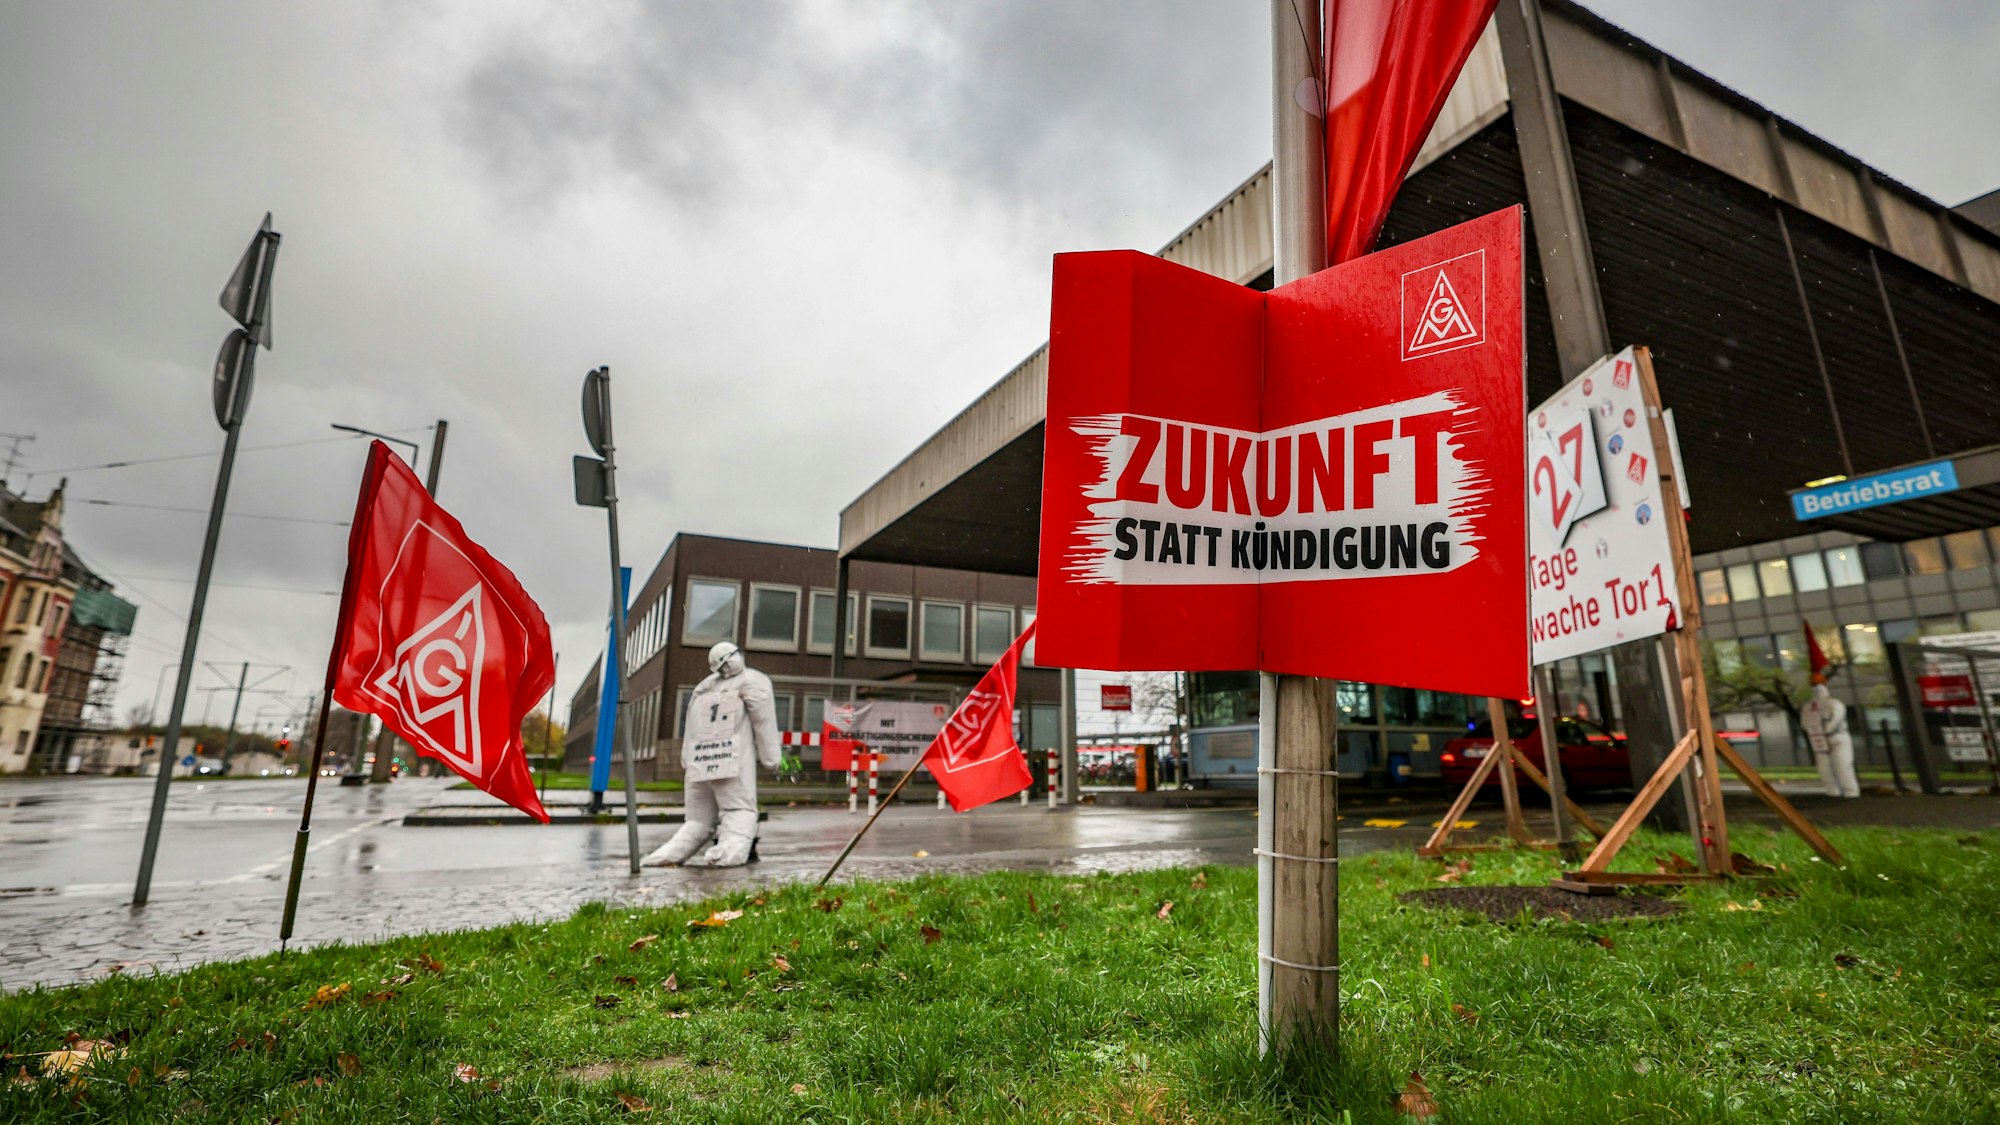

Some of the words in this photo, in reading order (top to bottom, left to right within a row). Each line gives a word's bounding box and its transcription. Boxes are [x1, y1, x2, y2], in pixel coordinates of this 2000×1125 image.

[1116, 409, 1458, 517] ZUKUNFT
[1533, 422, 1583, 530] 27
[1802, 469, 1943, 513] Betriebsrat
[1113, 517, 1222, 567] STATT
[1231, 521, 1450, 571] KÜNDIGUNG
[1530, 547, 1578, 590] Tage
[710, 704, 727, 722] 1.
[880, 719, 895, 728] MIT
